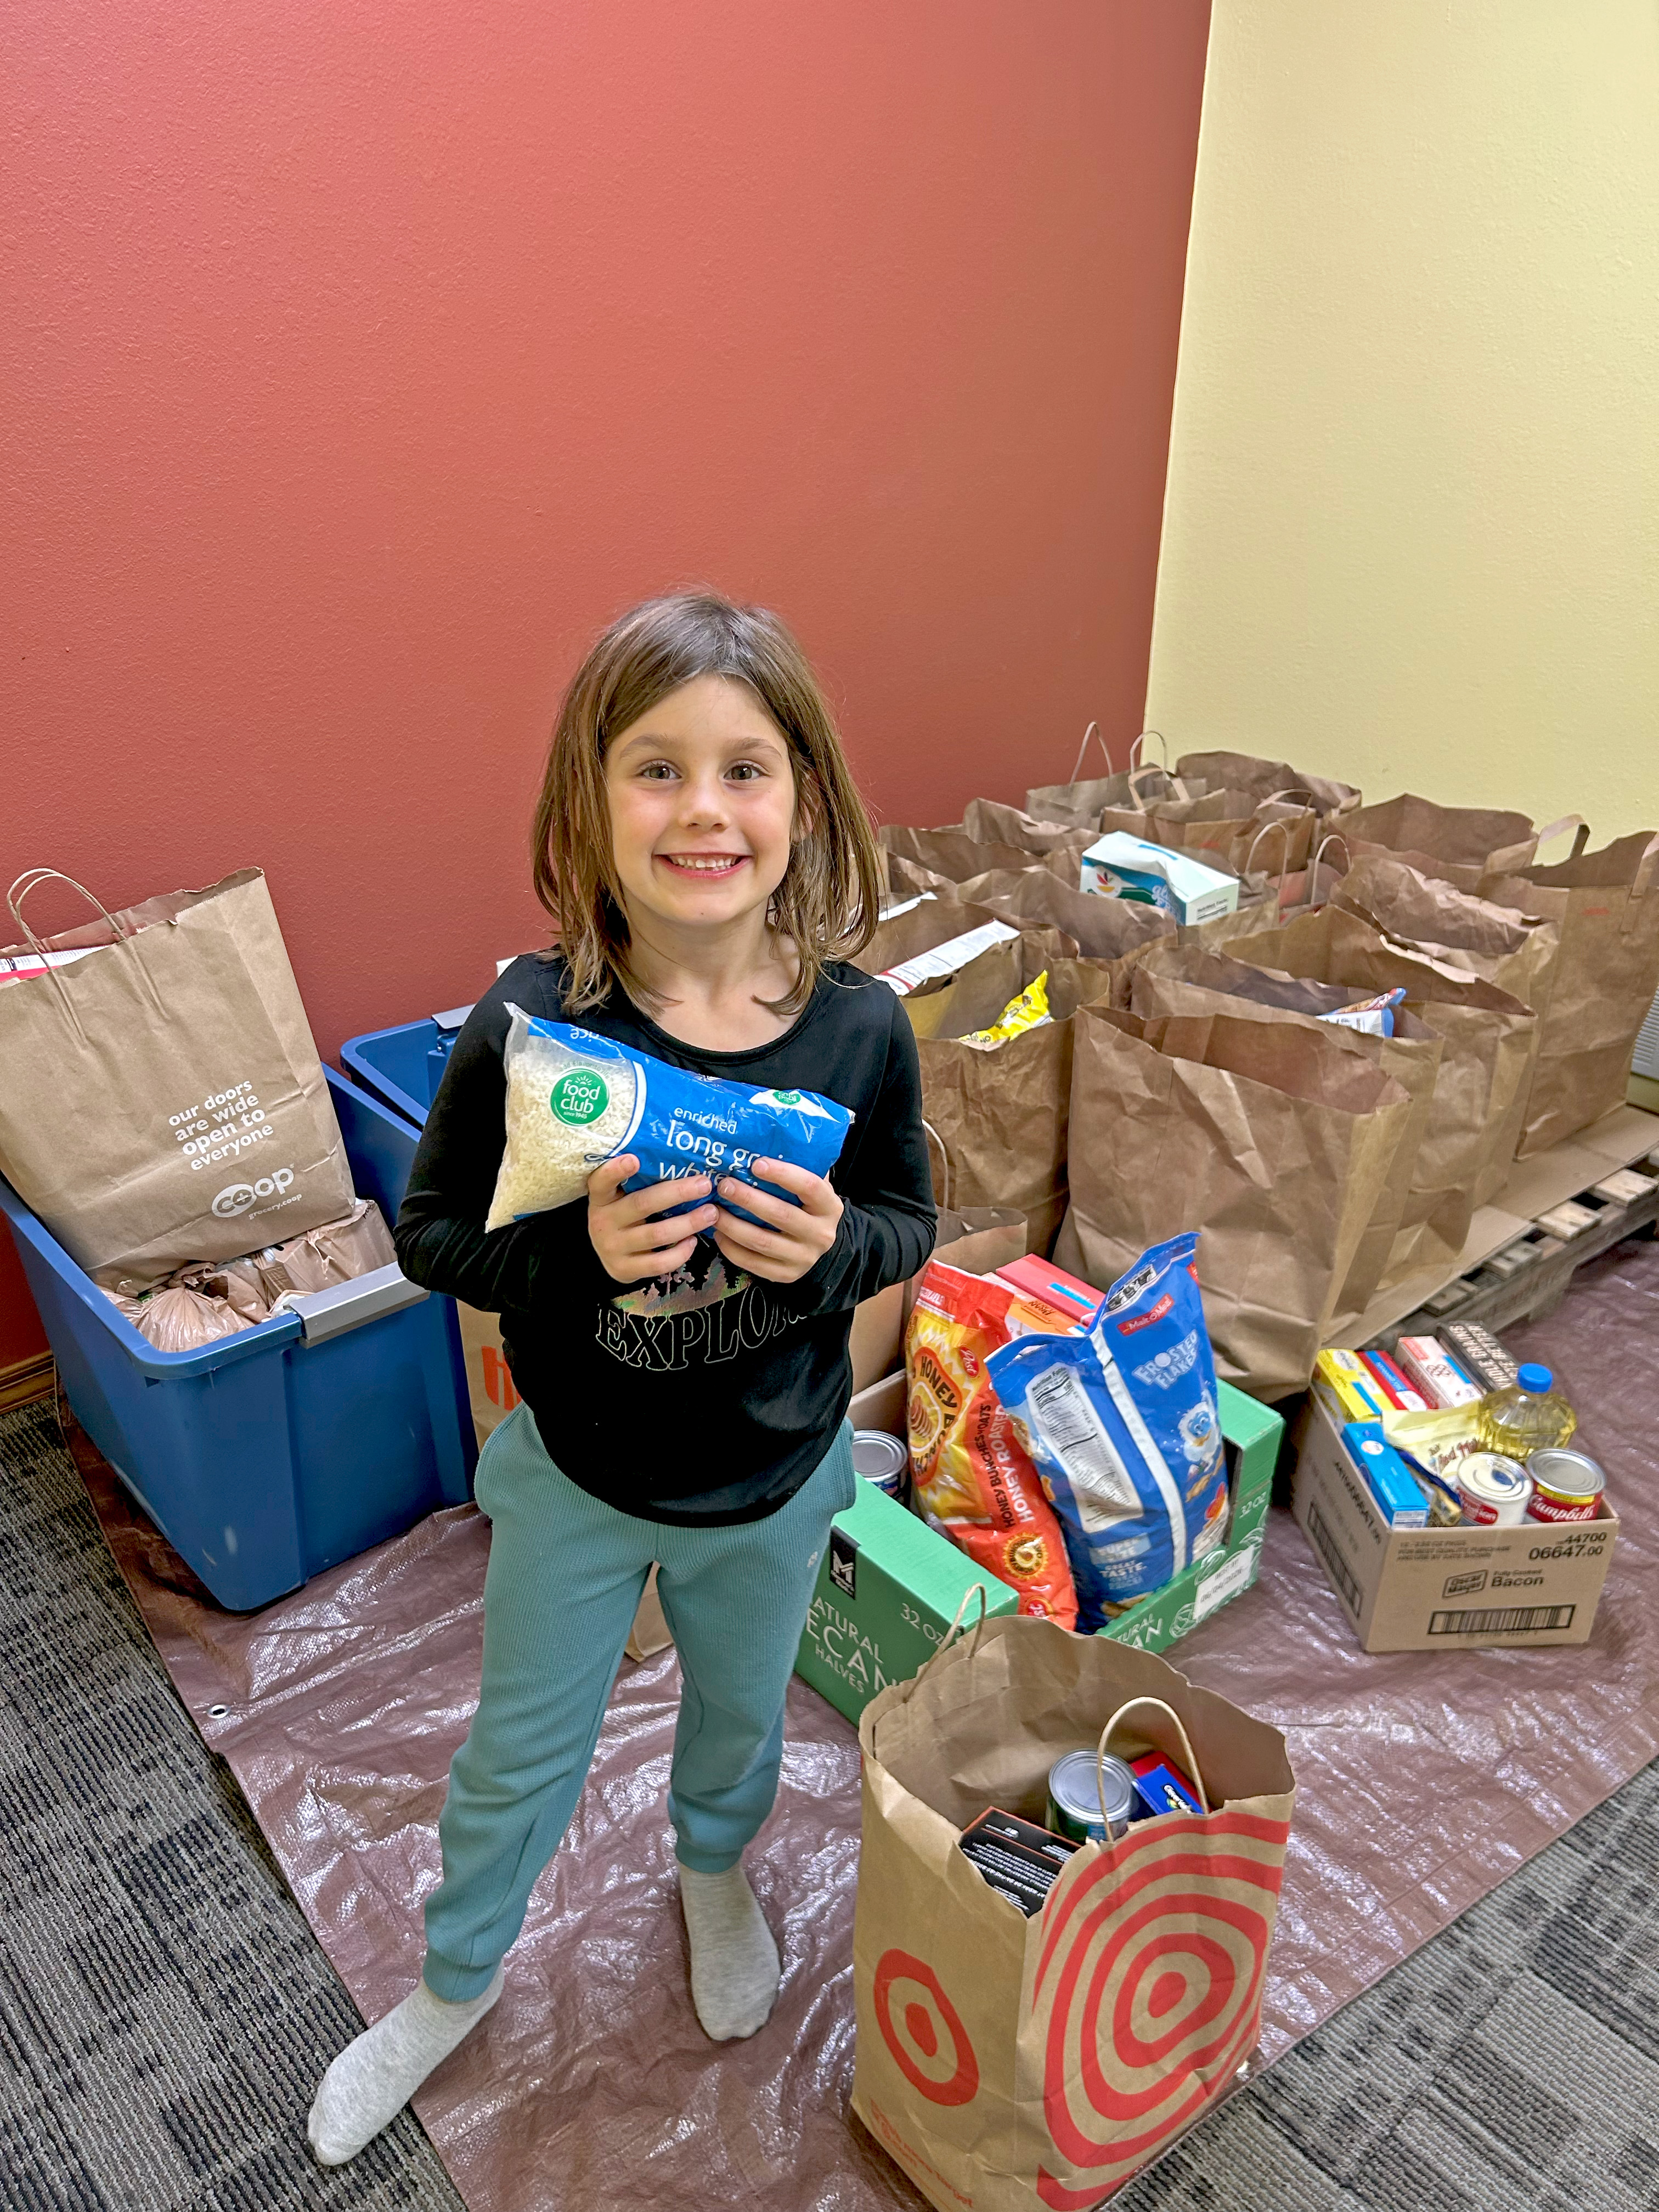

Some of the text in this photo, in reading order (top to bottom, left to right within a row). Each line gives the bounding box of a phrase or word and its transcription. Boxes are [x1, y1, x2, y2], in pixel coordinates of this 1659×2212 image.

[168, 1080, 252, 1126] our doors
[561, 1096, 594, 1114] club
[563, 1079, 601, 1100] food
[174, 1094, 259, 1141] are wide
[182, 1109, 266, 1155] open to
[674, 1107, 738, 1135] enriched
[190, 1125, 274, 1171] everyone
[667, 1119, 727, 1166] long
[249, 1193, 302, 1220] grocery.coop
[596, 1286, 808, 1371] EXPLO
[920, 1356, 957, 1408] HONEY
[960, 1348, 978, 1376] Post
[980, 1404, 991, 1430] OATS
[989, 1404, 1012, 1463] ROASTED
[975, 1435, 1002, 1487] BUNCHES
[994, 1488, 1015, 1528] HONEY
[1001, 1466, 1035, 1523] HONEY
[1528, 1544, 1604, 1561] 06647.00
[1564, 1532, 1607, 1545] 44700
[1491, 1576, 1544, 1588] Bacon
[812, 1596, 884, 1664] ATURAL
[900, 1602, 920, 1629] 32
[806, 1607, 898, 1691] ECAN
[816, 1643, 865, 1694] HALVES
